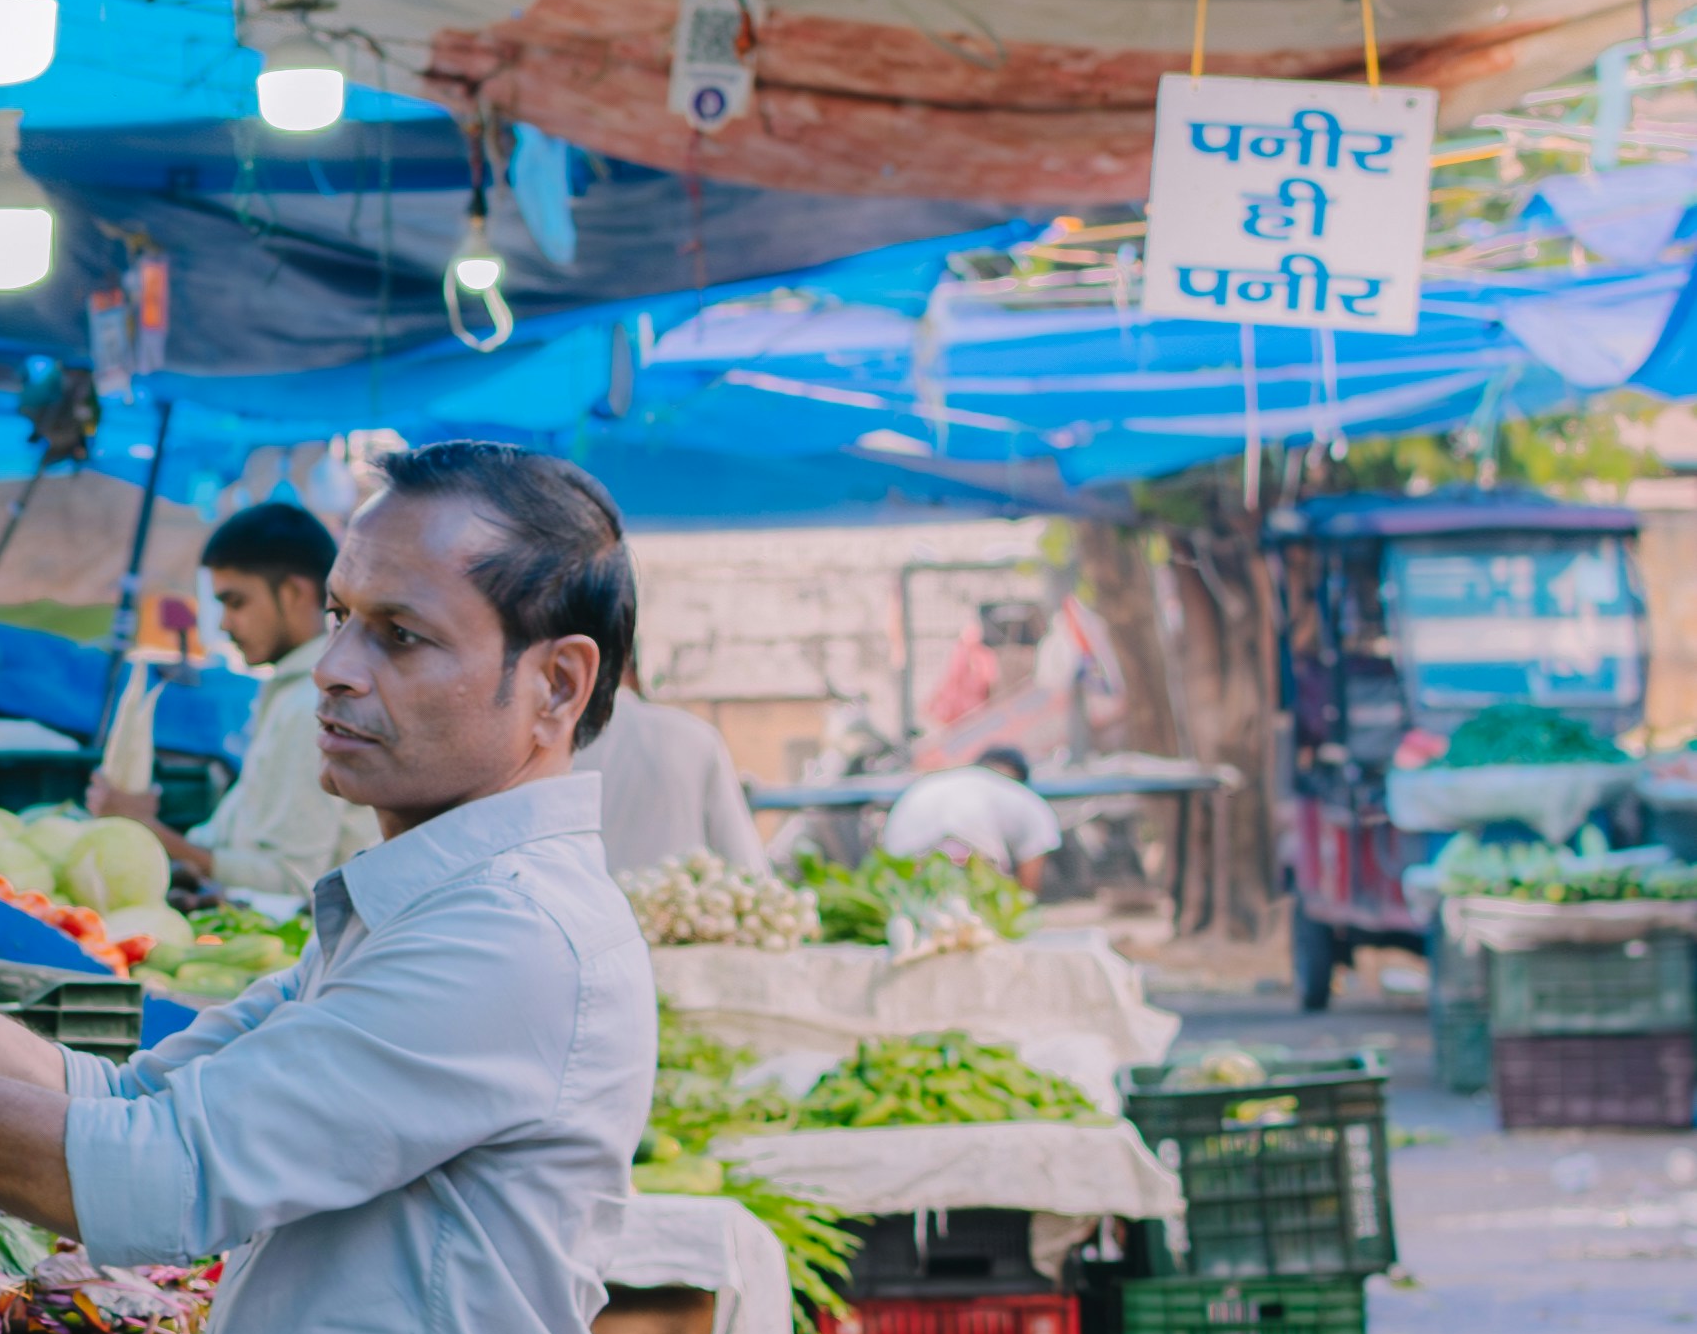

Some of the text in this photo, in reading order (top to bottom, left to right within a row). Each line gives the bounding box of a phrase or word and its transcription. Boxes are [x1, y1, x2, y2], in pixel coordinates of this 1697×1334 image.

[1186, 107, 1404, 174] पनीर
[1239, 177, 1336, 241] ही
[1173, 251, 1394, 318] पनीर
